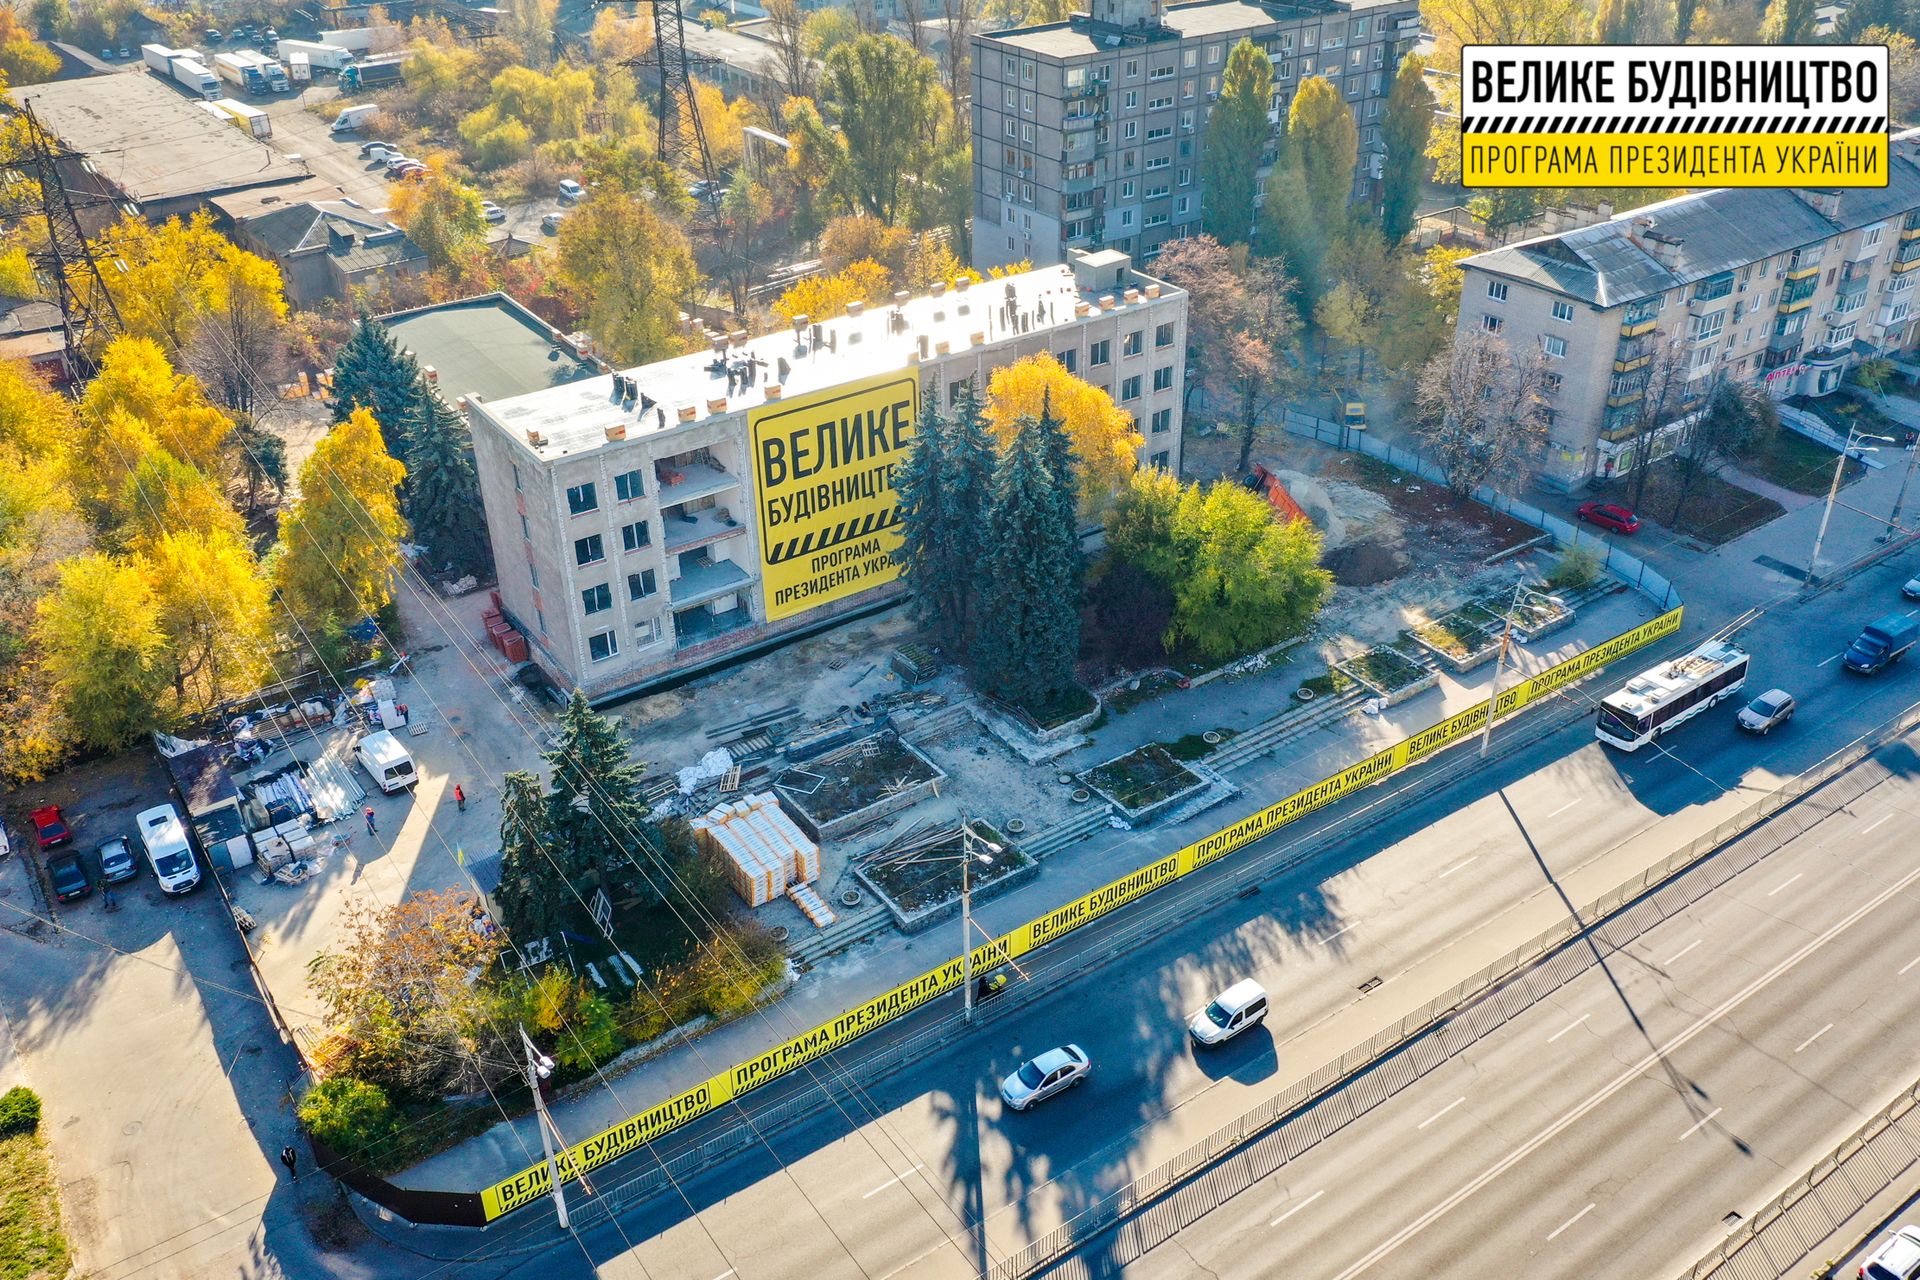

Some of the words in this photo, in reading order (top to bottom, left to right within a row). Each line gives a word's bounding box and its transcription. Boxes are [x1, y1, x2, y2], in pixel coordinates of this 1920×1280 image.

[762, 400, 910, 488] ВЕЛИКЕ
[768, 463, 898, 527] БУДІВНИЦТВ
[775, 564, 860, 606] ПРЕЗИДЕНТА
[811, 538, 881, 573] ПРОГРАМА
[1531, 659, 1581, 694] ПРОГРАМА
[1583, 632, 1640, 668] ПРЕЗИДЕНТА
[1409, 724, 1449, 755] ВЕЛИКЕ
[1197, 816, 1262, 859] ПРОГРАМА
[1266, 780, 1341, 825] ПРЕЗИДЕНТА
[1344, 752, 1393, 787] УКРАЇНИ
[1033, 900, 1085, 939] ВЕЛИКЕ
[1089, 858, 1177, 911] БУДІВНИЦТВО
[736, 1028, 829, 1085] ПРОГРАМА
[834, 974, 939, 1037] ПРЕЗИДЕНТА
[942, 939, 1007, 982] УКАЇНИ
[501, 1151, 579, 1202] ВЕЛИКЕ
[583, 1088, 708, 1161] БУДІВНИЦТВО
